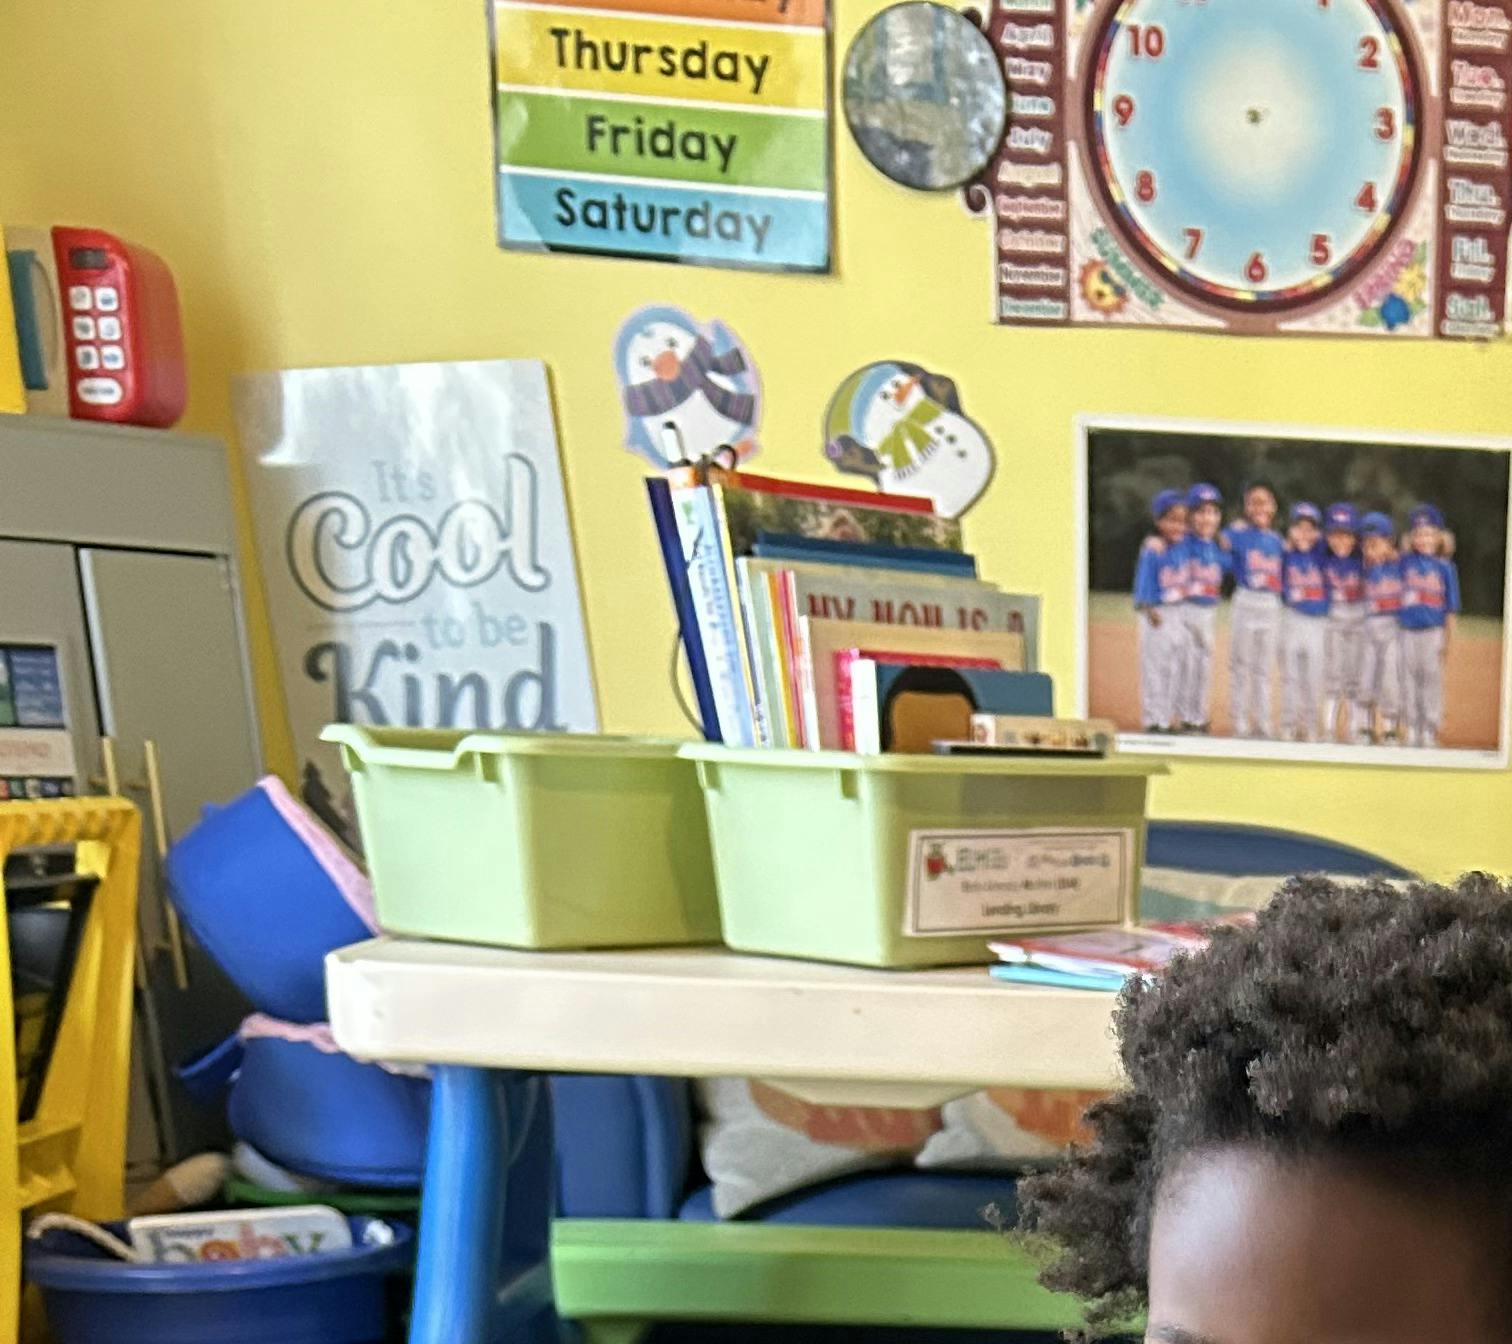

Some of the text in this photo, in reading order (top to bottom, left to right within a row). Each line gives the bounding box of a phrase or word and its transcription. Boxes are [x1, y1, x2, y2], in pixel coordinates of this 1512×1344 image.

[1127, 24, 1165, 58] 10
[1358, 37, 1381, 70] 2
[549, 26, 771, 95] Thursday
[1112, 94, 1135, 126] 9
[1375, 108, 1396, 140] 3
[585, 113, 738, 174] Friday
[1134, 170, 1157, 203] 8
[1353, 182, 1378, 213] 4
[553, 187, 773, 254] Saturday
[1182, 228, 1204, 260] 7
[1309, 234, 1331, 265] 5
[1245, 252, 1267, 283] 6
[286, 452, 551, 613] Cool
[421, 599, 529, 649] to be
[304, 621, 569, 733] Kind
